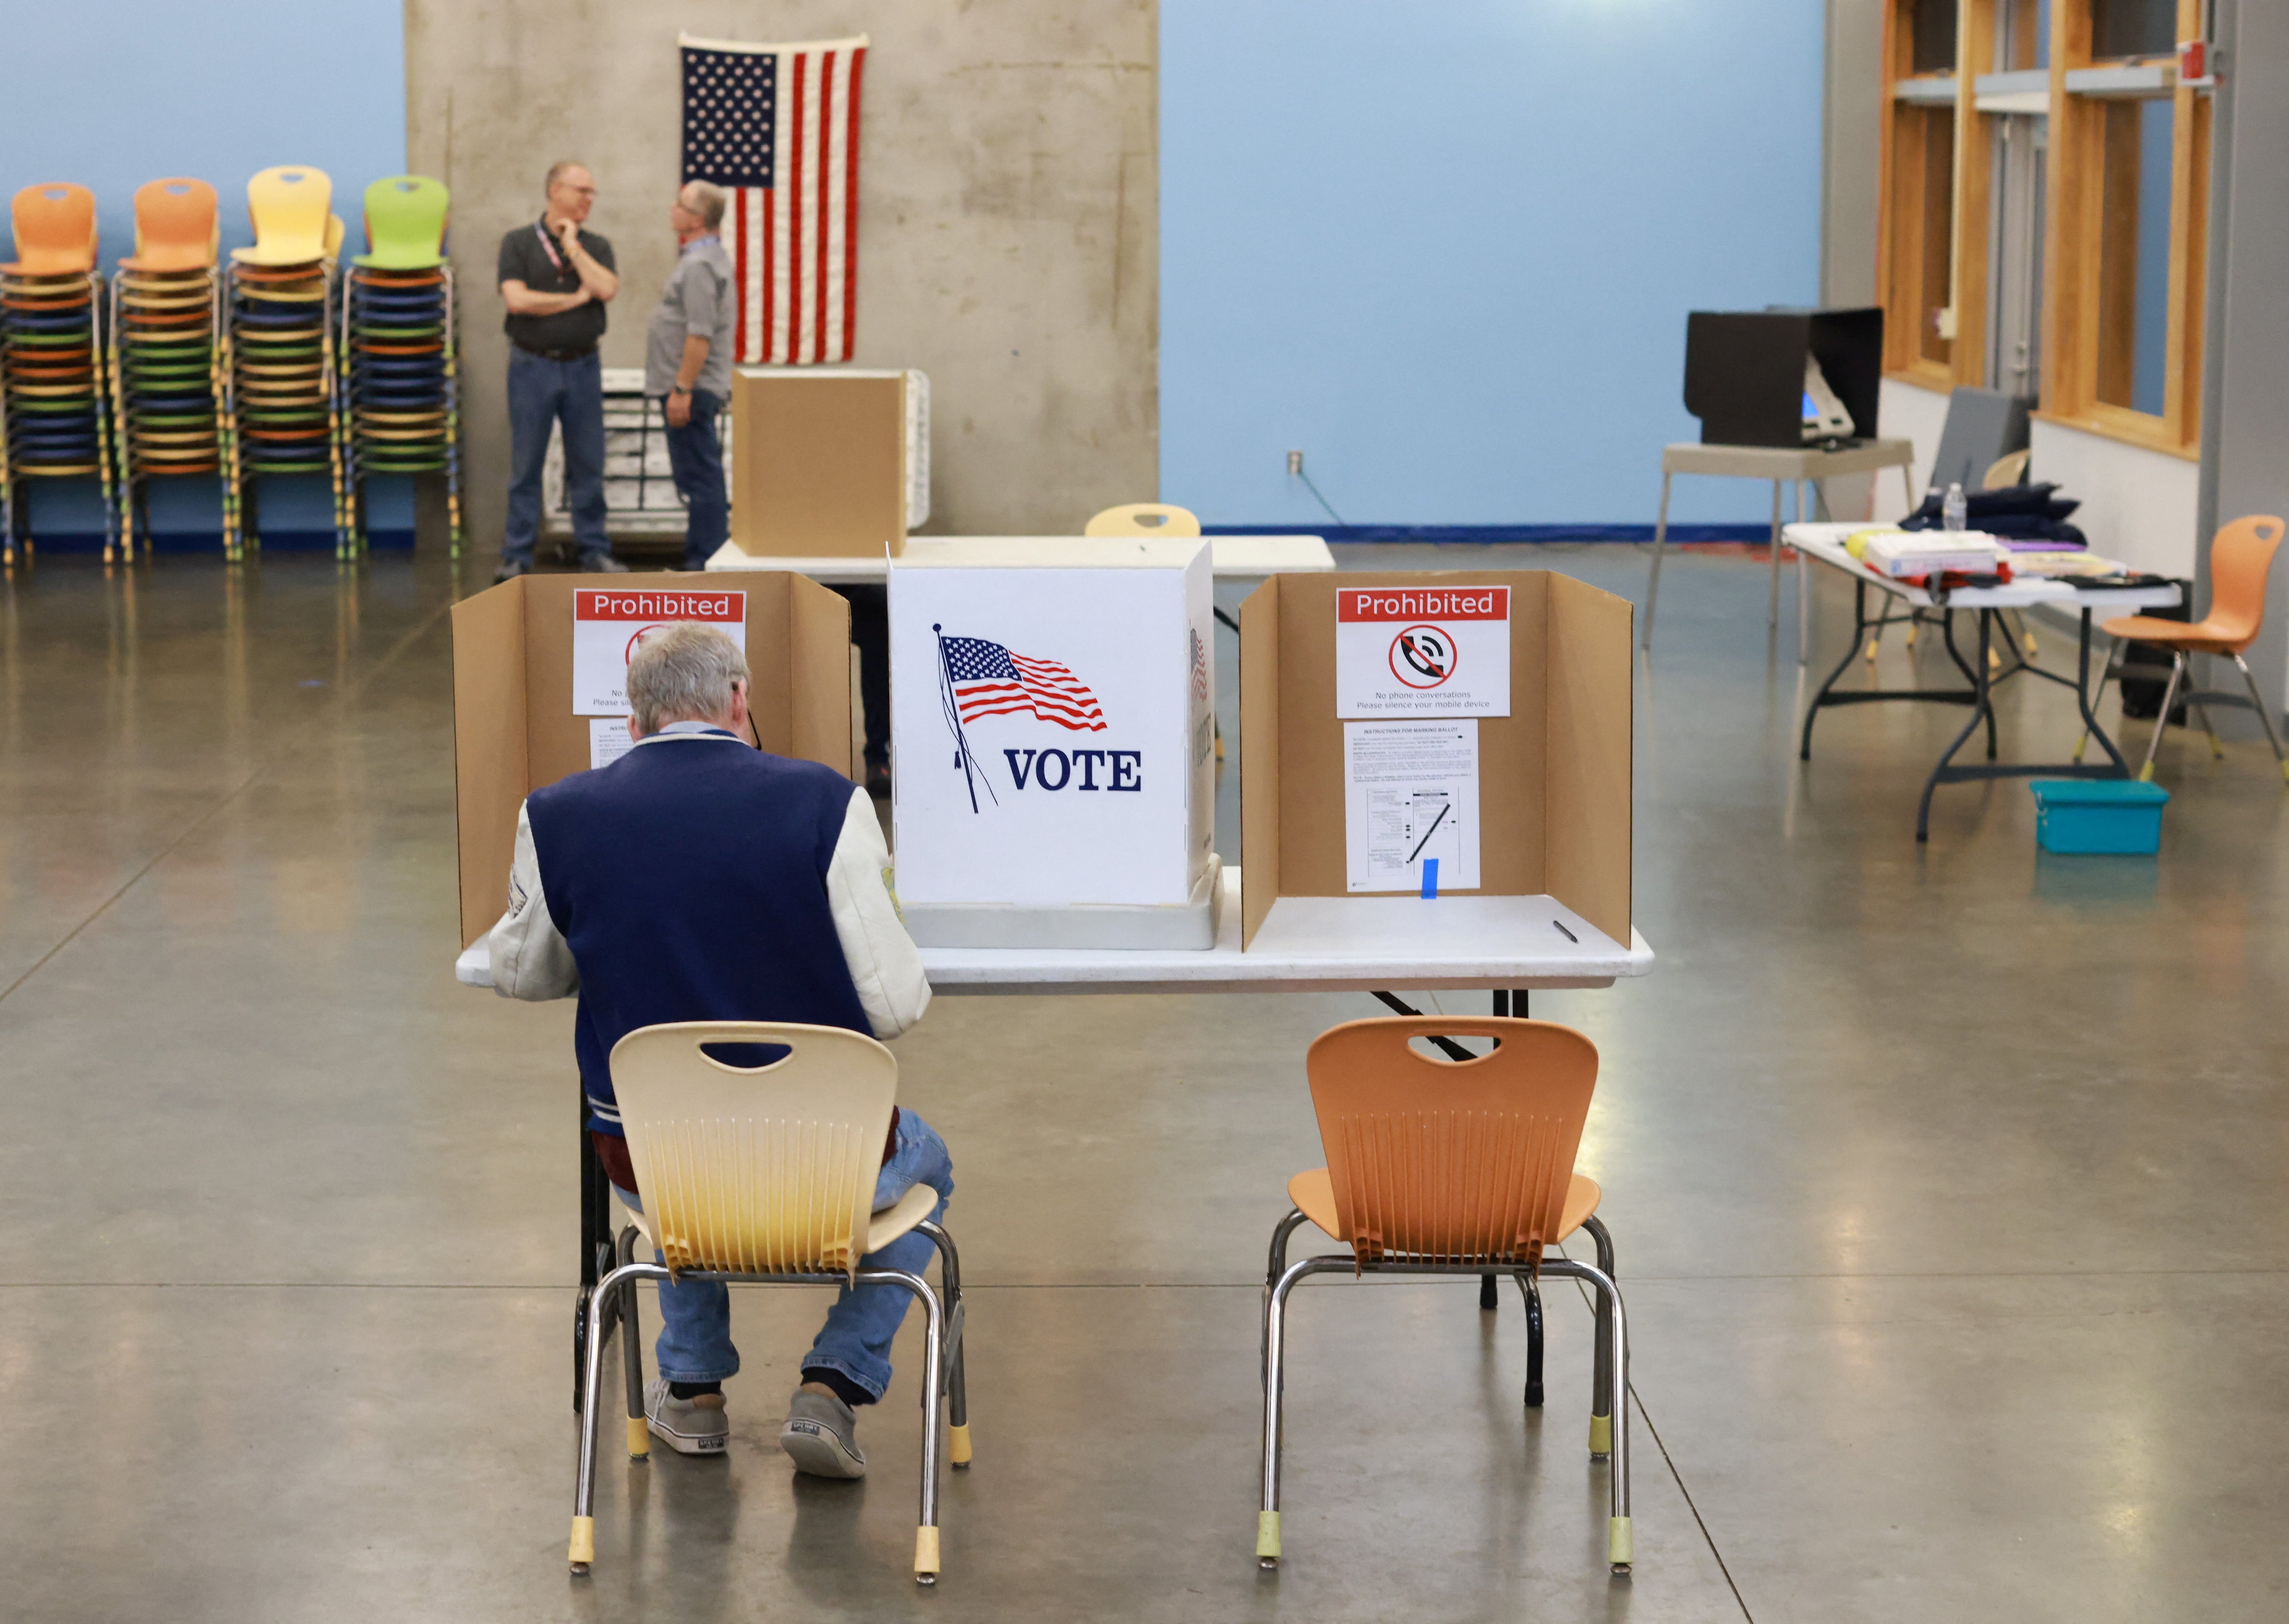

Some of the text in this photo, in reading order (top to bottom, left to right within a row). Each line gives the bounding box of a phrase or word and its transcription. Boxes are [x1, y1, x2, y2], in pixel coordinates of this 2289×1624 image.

[594, 594, 729, 616] Prohibited
[1357, 592, 1493, 615] Prohibited
[1389, 692, 1414, 701] phone
[1003, 748, 1142, 792] VOTE
